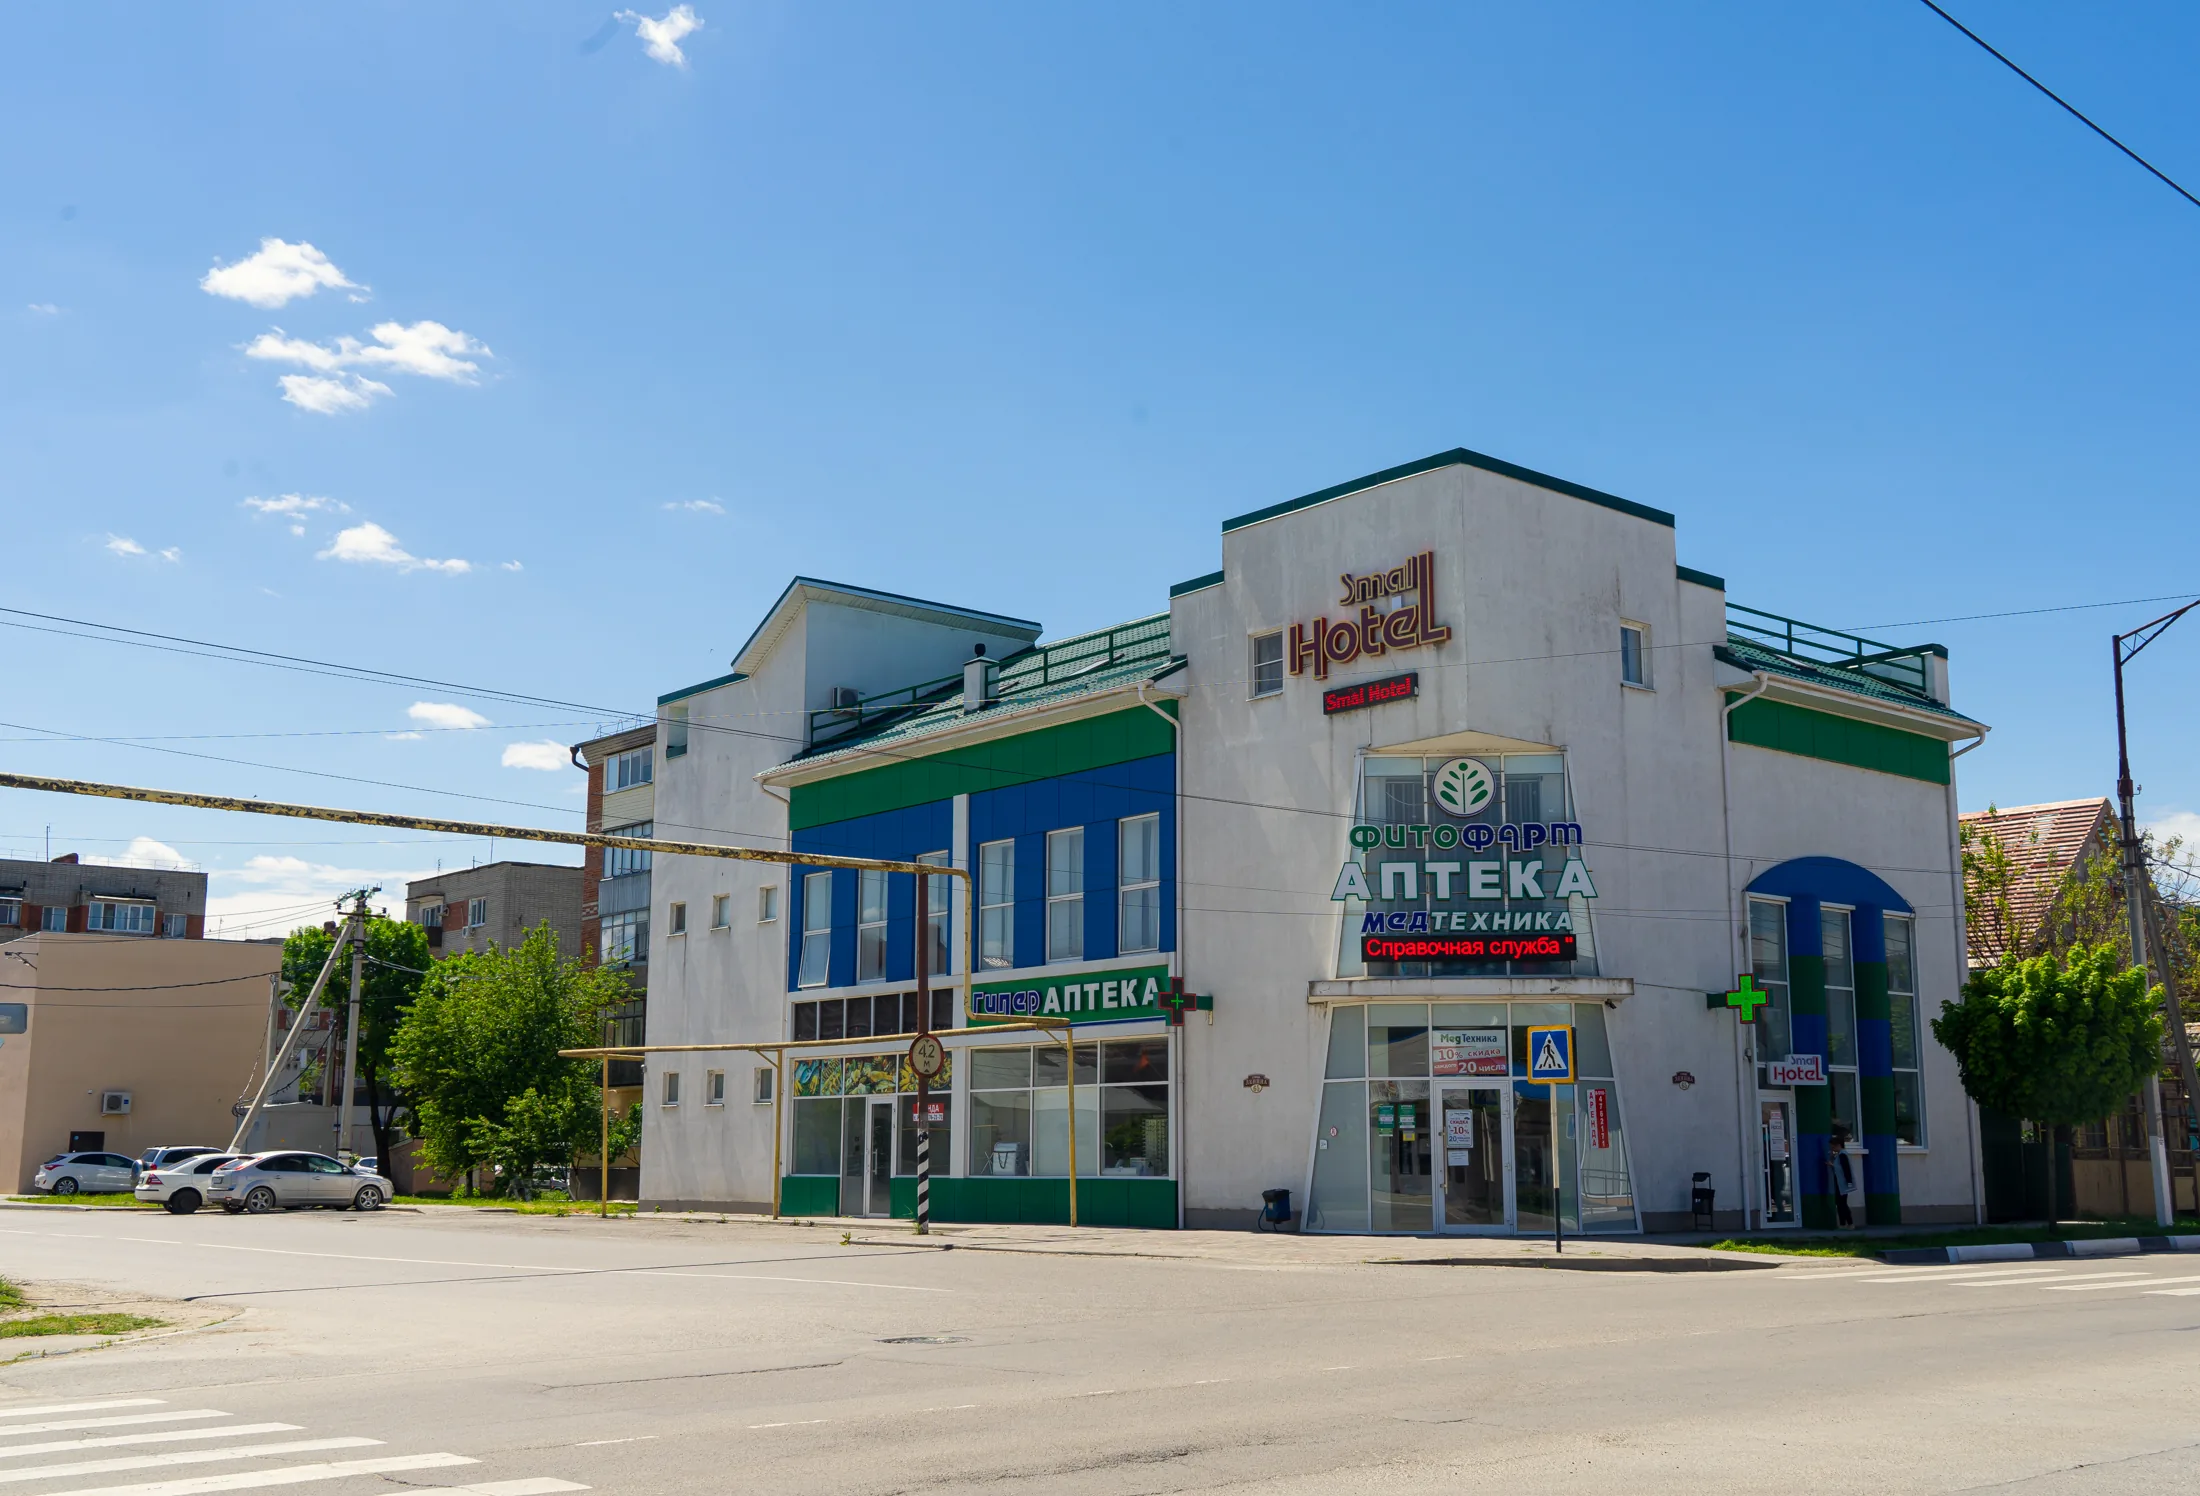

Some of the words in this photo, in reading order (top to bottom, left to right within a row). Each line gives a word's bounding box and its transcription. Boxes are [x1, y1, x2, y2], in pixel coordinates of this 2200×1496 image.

[1368, 677, 1411, 702] Hotel
[1331, 858, 1599, 901] АПТЕКА
[1366, 939, 1484, 960] Справочная
[1489, 936, 1560, 960] служба
[1438, 1048, 1463, 1061] 10%
[1458, 1062, 1477, 1073] 20
[1479, 1064, 1506, 1072] числа
